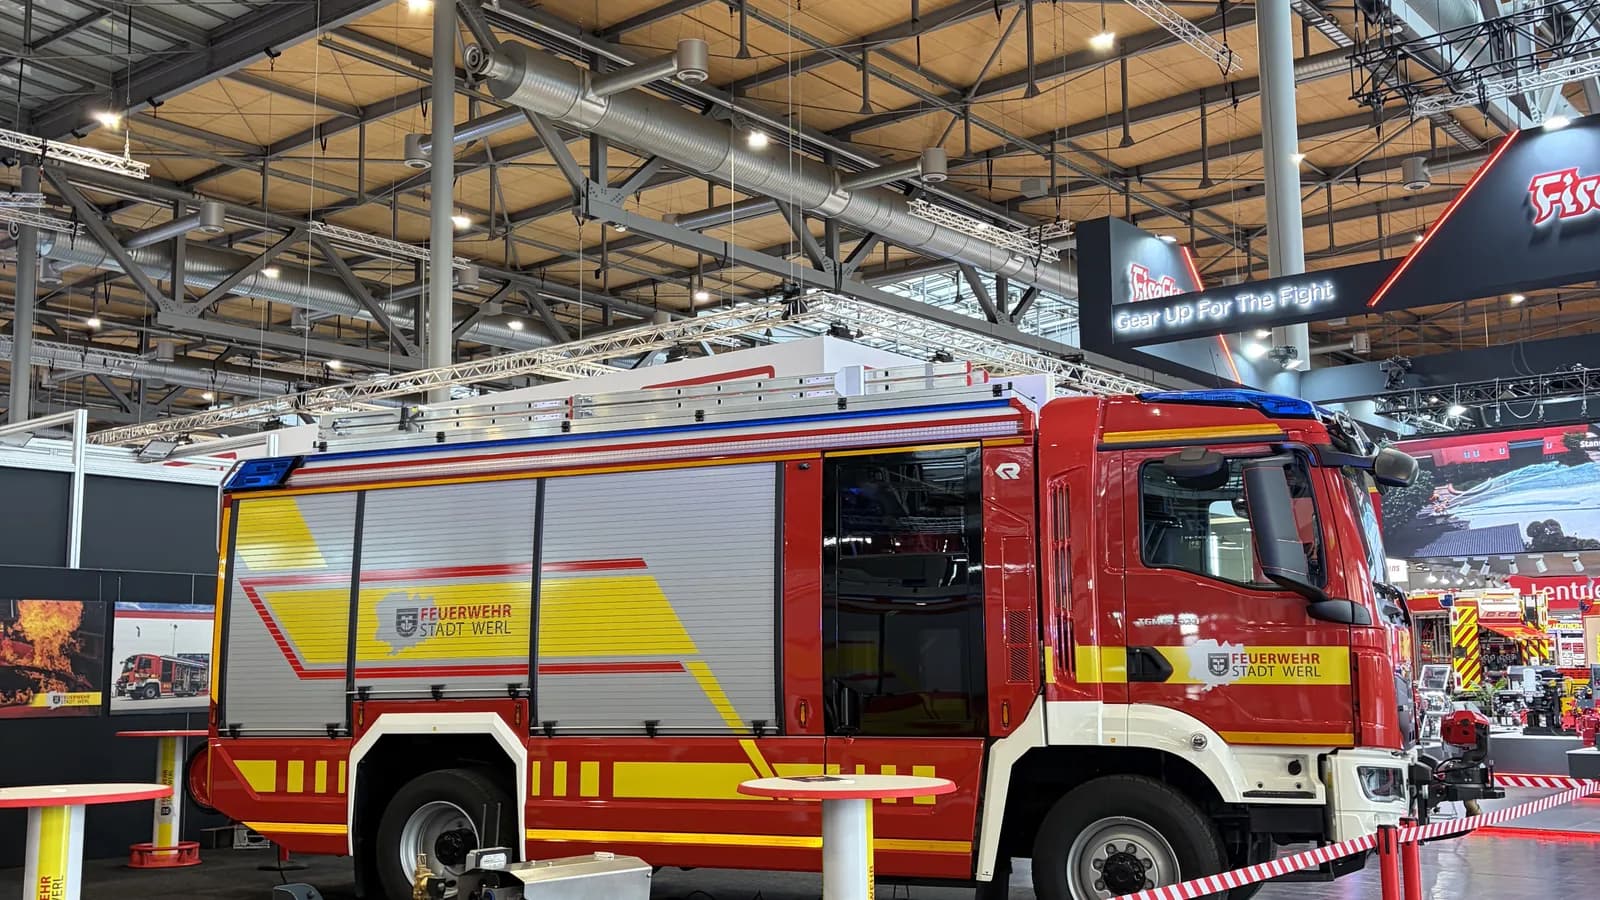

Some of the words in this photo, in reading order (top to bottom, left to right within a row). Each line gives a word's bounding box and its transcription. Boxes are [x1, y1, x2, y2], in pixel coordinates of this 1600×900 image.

[1116, 312, 1160, 331] Gear
[1165, 305, 1191, 323] Up
[1197, 300, 1232, 319] For
[1235, 293, 1273, 312] The
[1280, 281, 1335, 307] Fight
[1580, 439, 1600, 448] Stan
[420, 604, 512, 621] FEUERWEHR
[420, 622, 465, 637] STADT
[472, 621, 512, 635] WERL
[1231, 653, 1320, 664] FEUERWEHR
[1232, 665, 1275, 677] STADT
[1283, 665, 1321, 677] WERL
